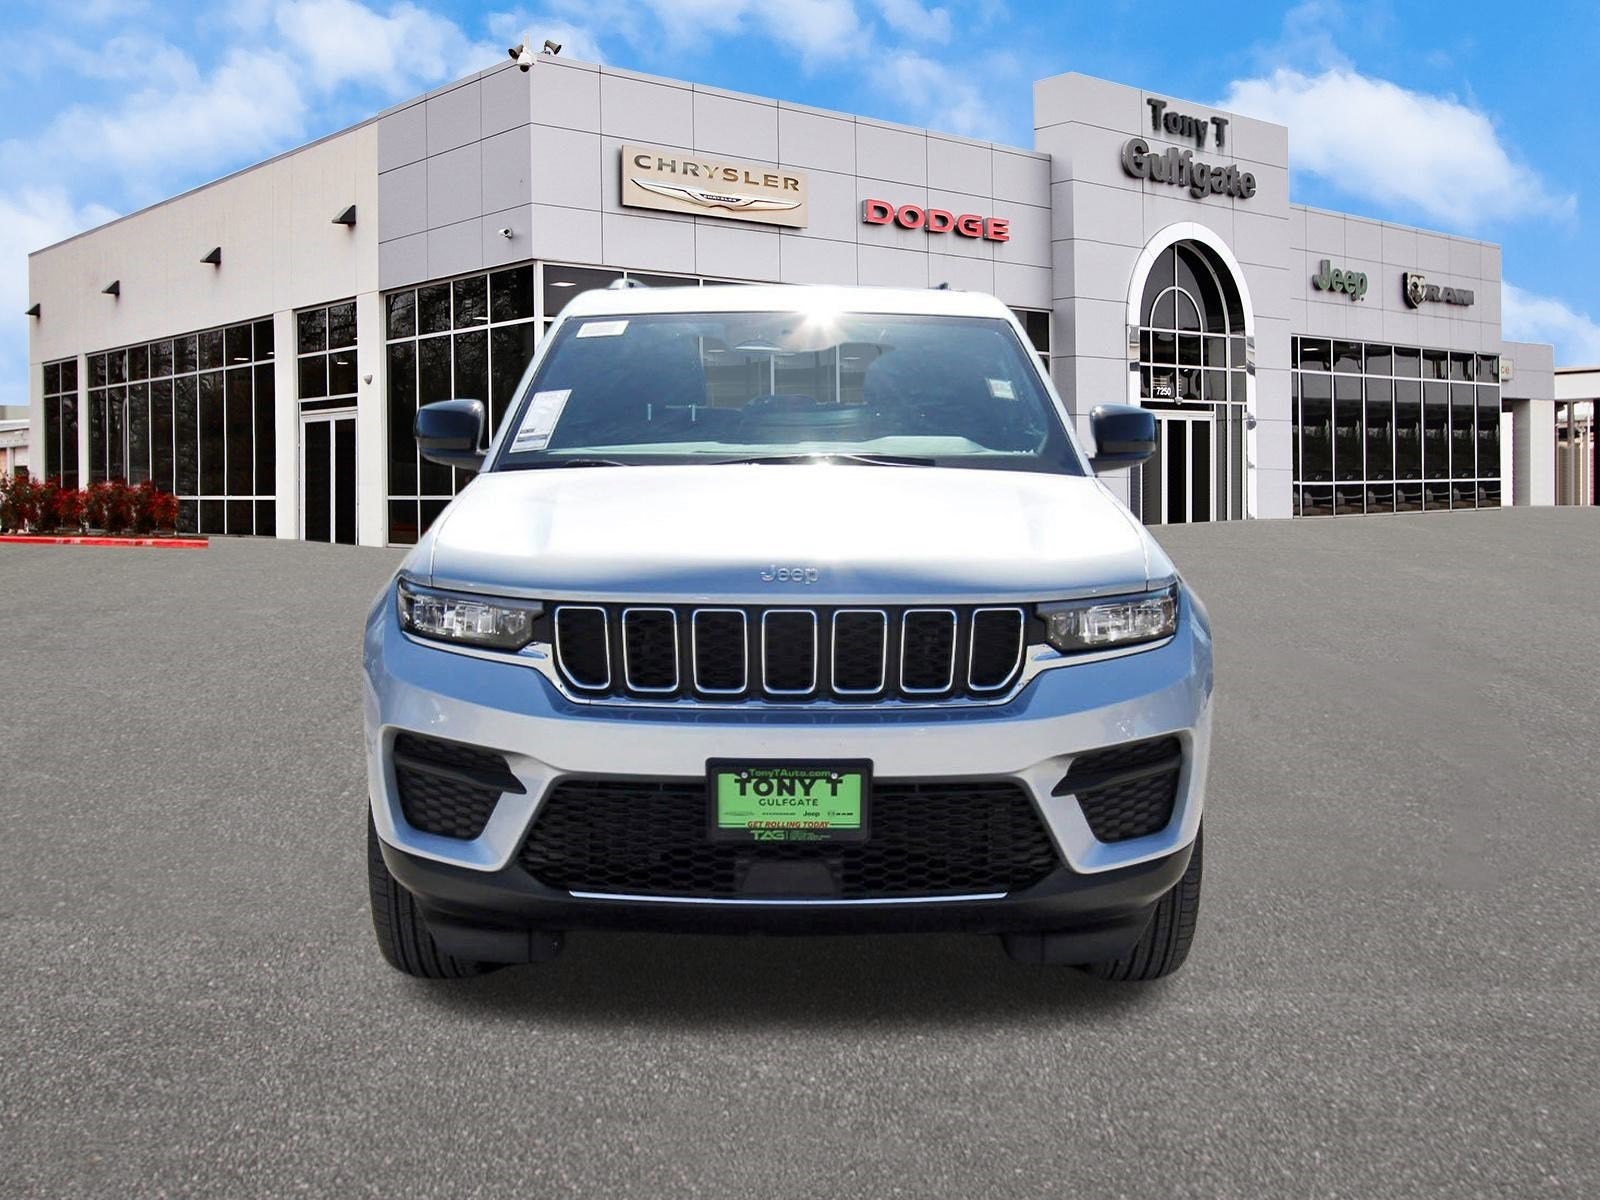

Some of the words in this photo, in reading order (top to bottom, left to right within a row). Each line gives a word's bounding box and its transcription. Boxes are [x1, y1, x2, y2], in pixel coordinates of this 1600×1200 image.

[1147, 98, 1209, 148] Tony
[1210, 116, 1229, 148] T
[633, 154, 801, 192] CHRYSLER
[1121, 137, 1257, 199] Gulfgate
[862, 198, 1011, 242] DODGE
[1312, 259, 1368, 301] Jeep
[1423, 284, 1475, 306] RAM
[1156, 387, 1171, 396] 7250
[760, 564, 819, 585] Jeep
[749, 768, 831, 779] TonyTAuto.com
[734, 778, 817, 797] TONY
[825, 778, 843, 797] T
[758, 798, 819, 807] GULFGATE
[747, 820, 763, 829] GET
[764, 820, 802, 829] ROLLING
[803, 820, 830, 829] TODAY
[750, 829, 785, 841] TAG
